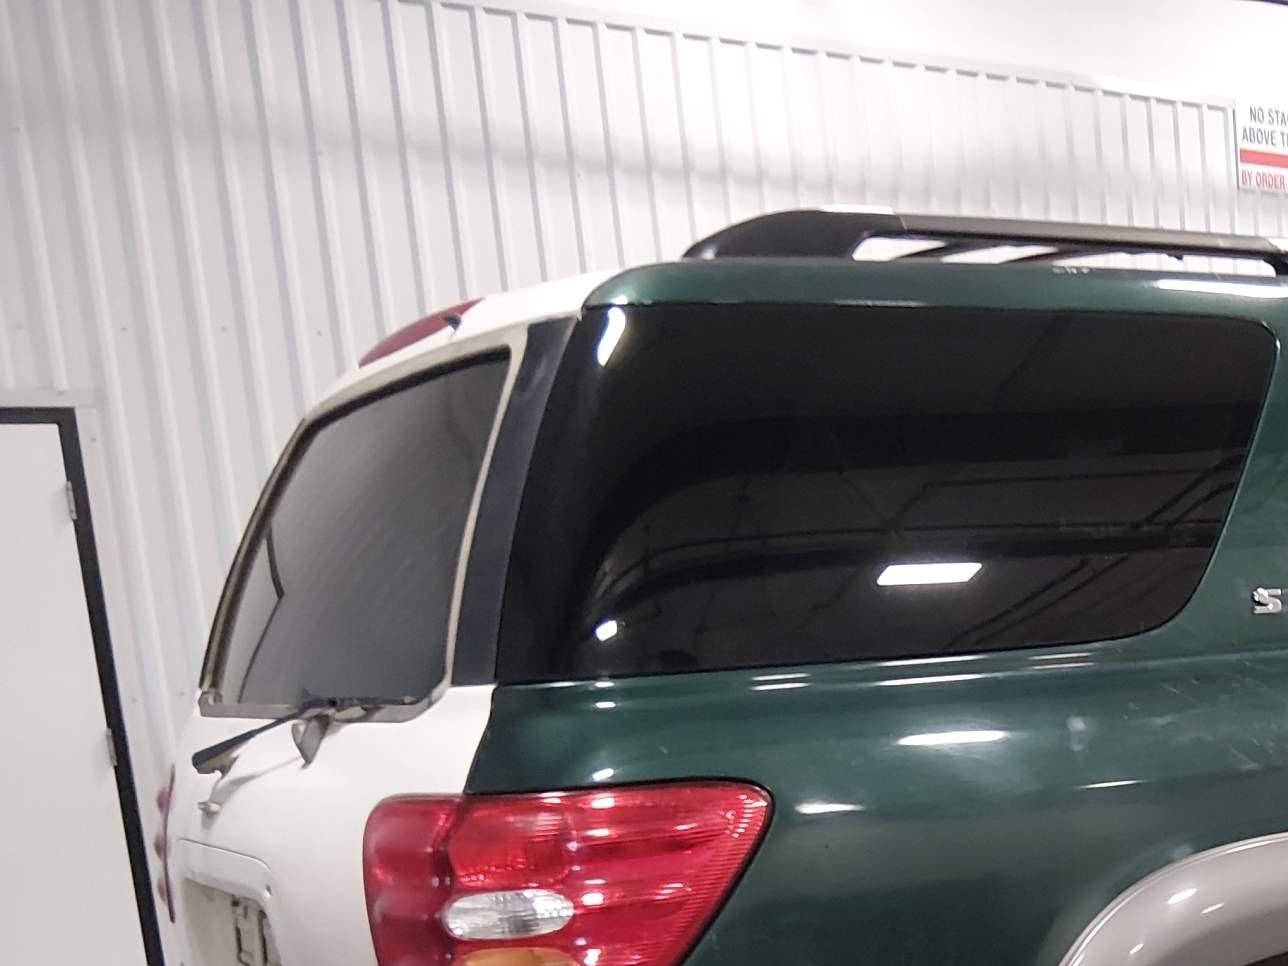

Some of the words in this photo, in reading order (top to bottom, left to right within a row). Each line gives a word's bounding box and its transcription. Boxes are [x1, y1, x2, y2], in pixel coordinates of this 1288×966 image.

[1249, 106, 1265, 124] NO
[1242, 127, 1277, 147] ABOVE
[1241, 169, 1253, 187] BY
[1255, 171, 1285, 191] ORDER
